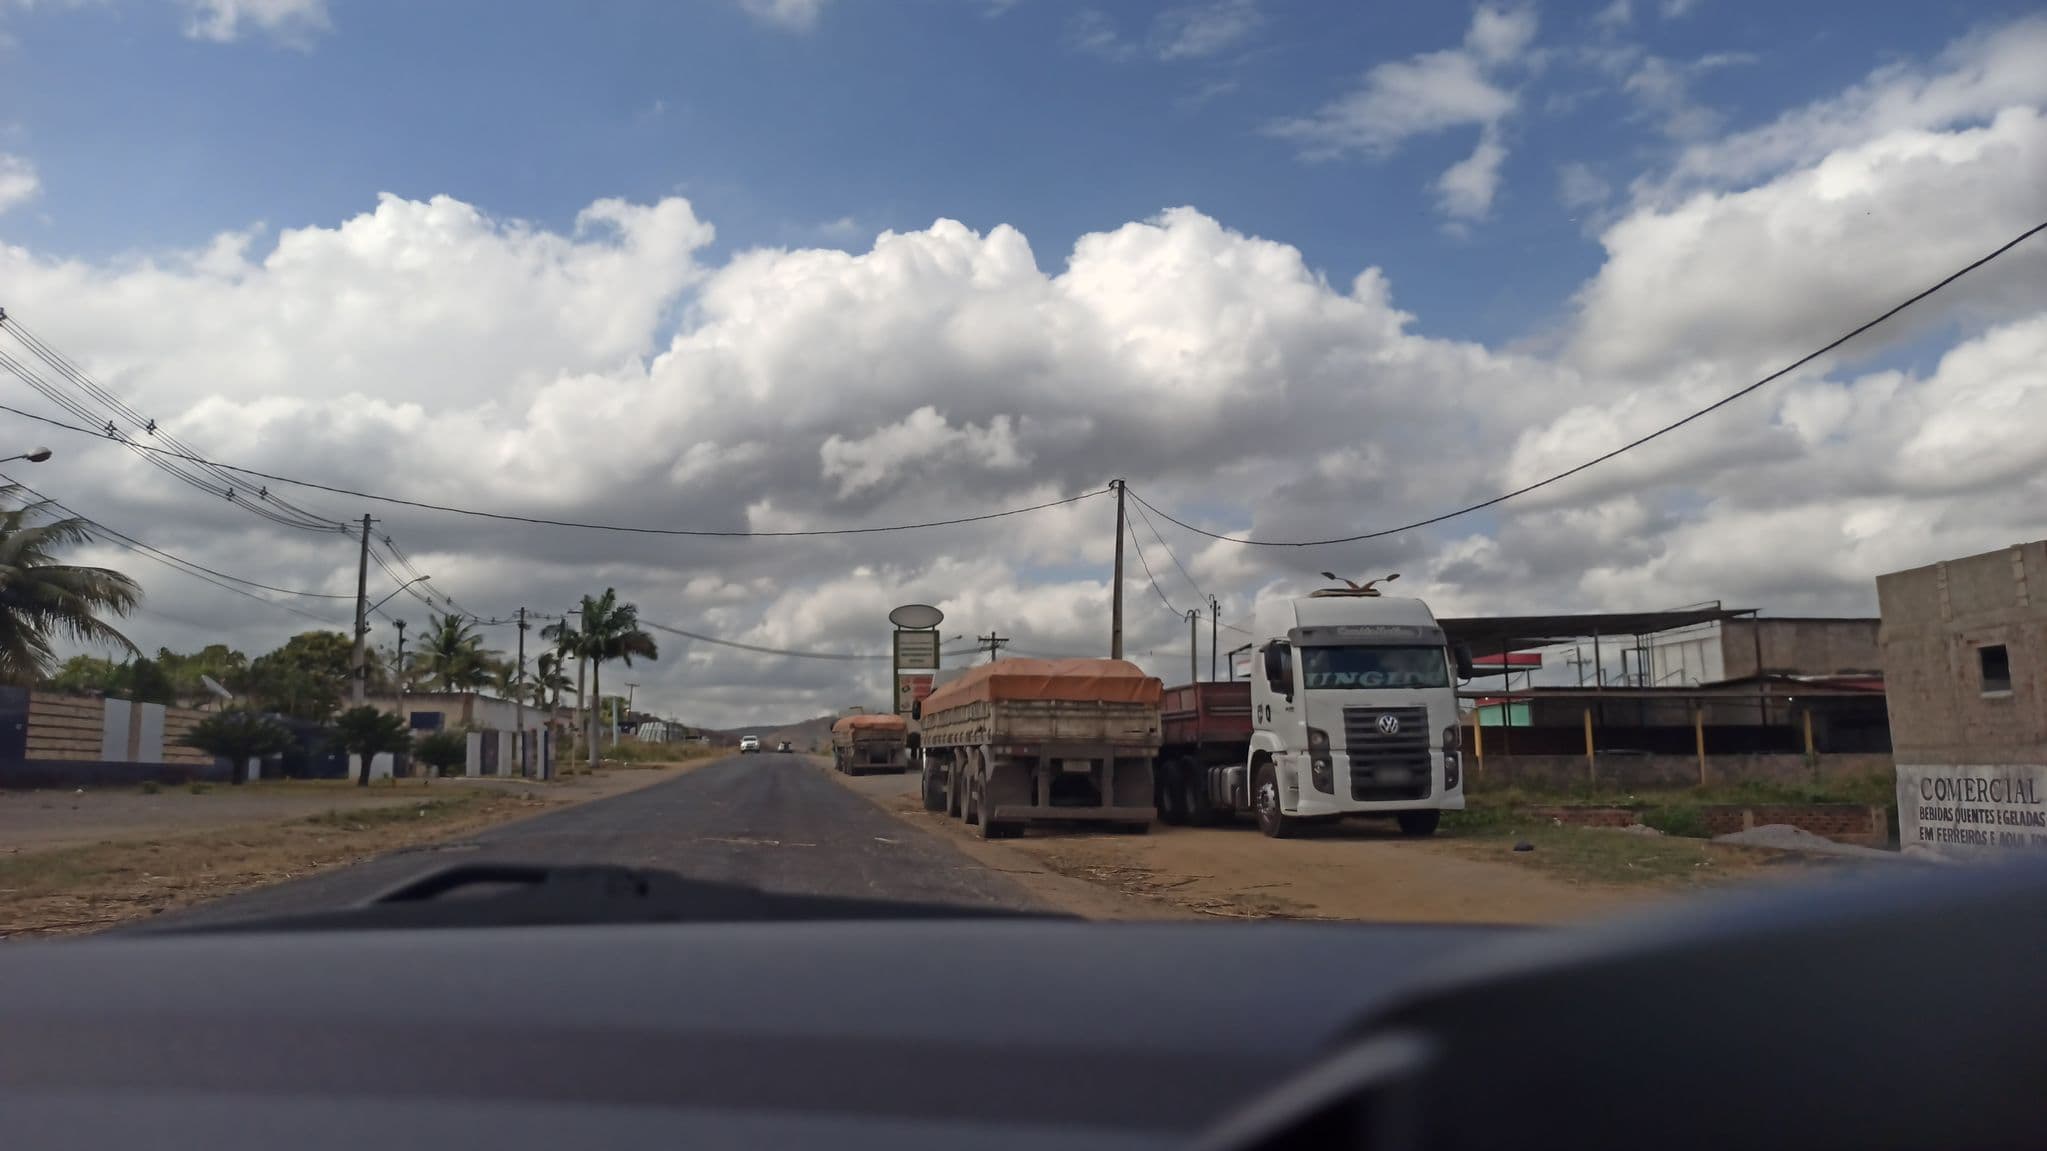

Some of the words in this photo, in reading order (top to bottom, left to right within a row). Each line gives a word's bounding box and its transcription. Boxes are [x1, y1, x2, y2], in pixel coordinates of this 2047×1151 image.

[1920, 776, 2041, 803] COMERCIAL
[1919, 806, 1954, 822] BEBIDAS
[1955, 808, 1995, 824] QUENTES
[1997, 810, 2002, 824] E
[2003, 811, 2046, 827] GELADAS
[1919, 826, 1934, 841] EM
[1936, 828, 1987, 845] FERREIROS
